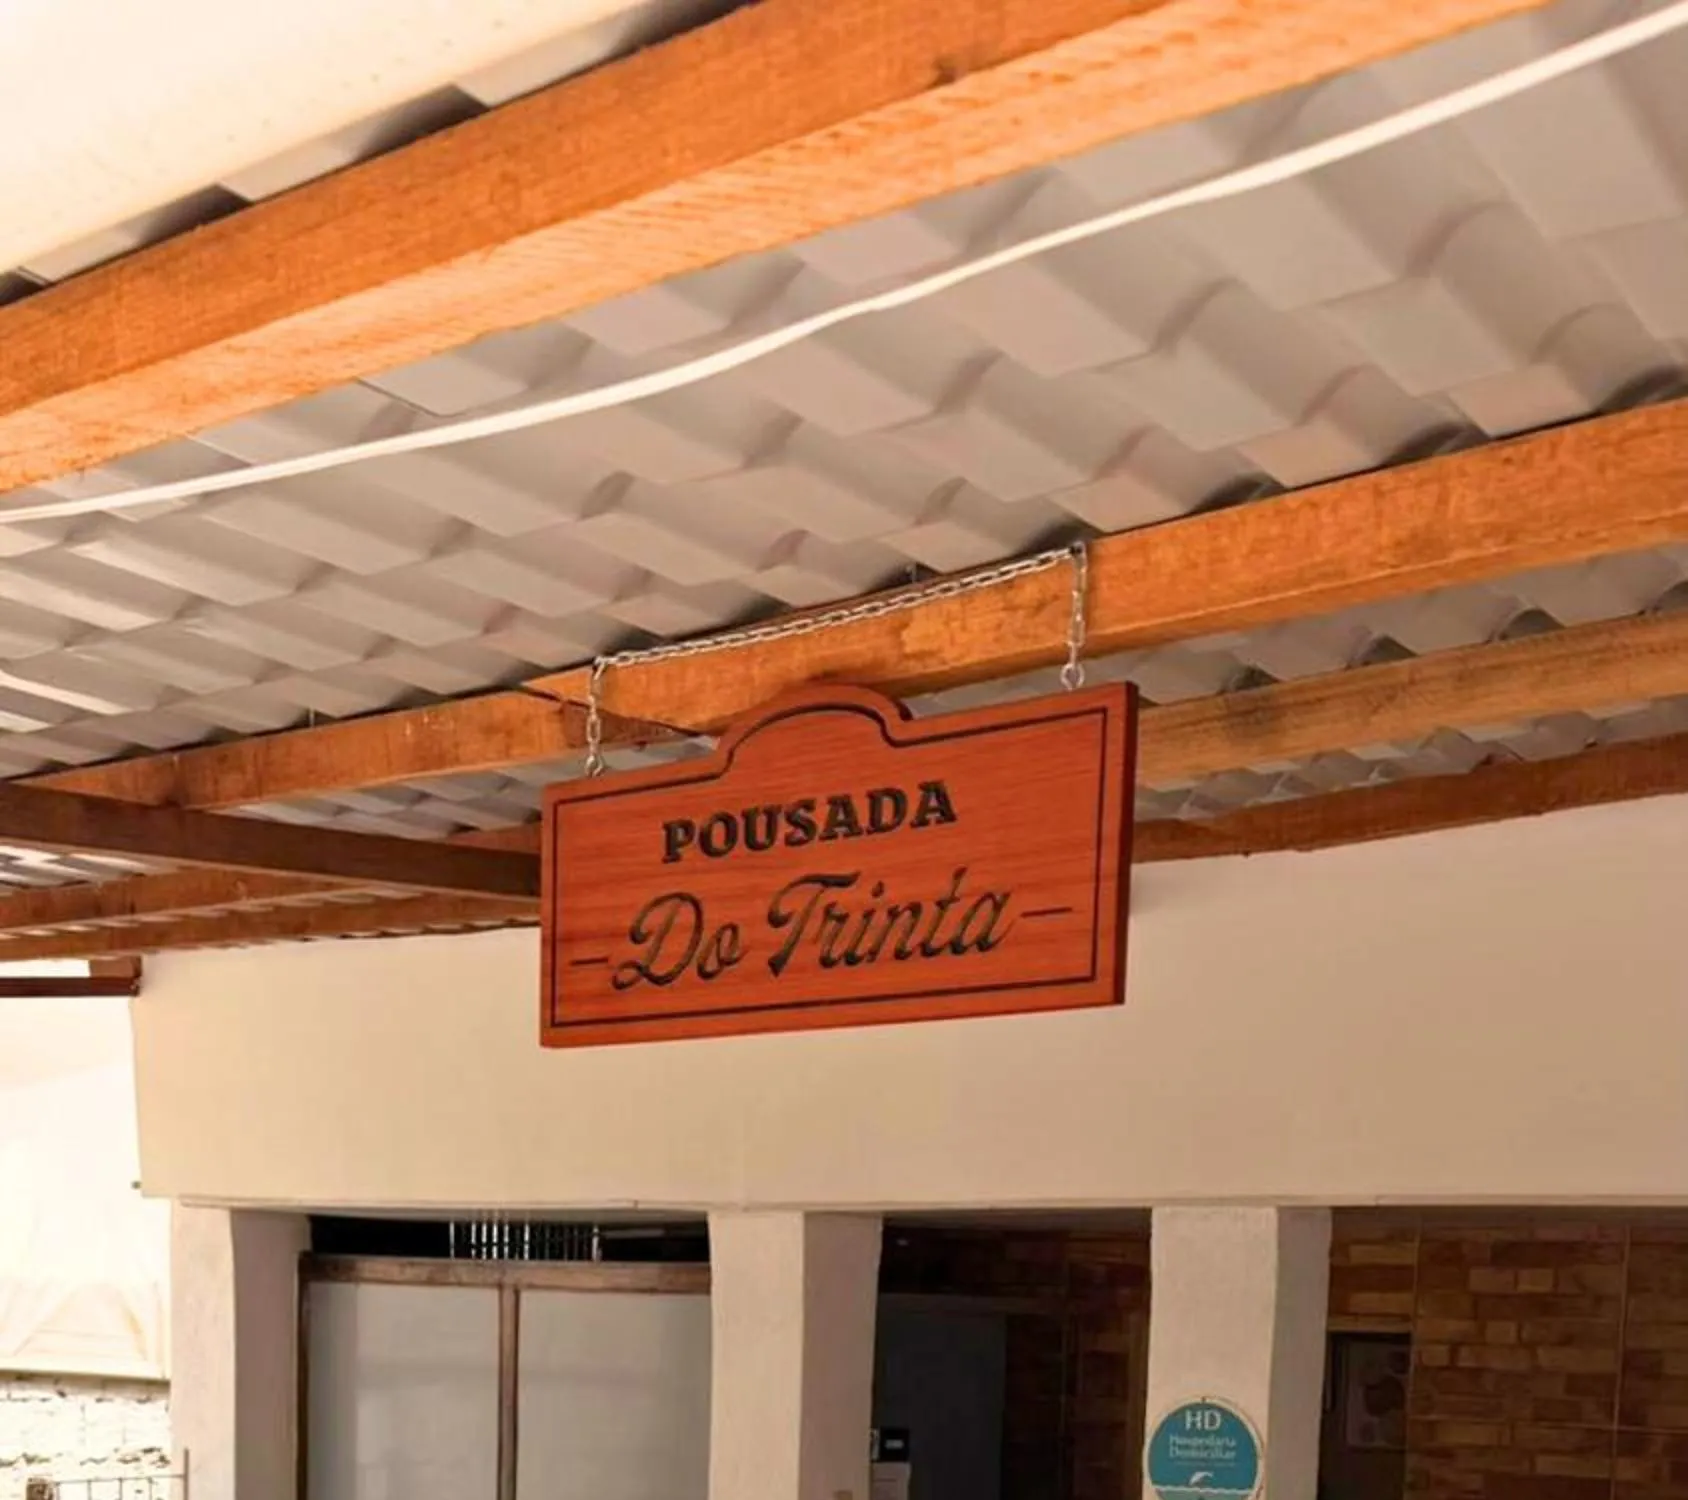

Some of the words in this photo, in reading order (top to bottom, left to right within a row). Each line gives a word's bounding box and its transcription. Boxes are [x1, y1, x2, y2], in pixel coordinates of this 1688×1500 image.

[661, 780, 958, 864] POUSADA
[610, 890, 748, 992] Do
[766, 866, 1014, 978] Trinta
[1184, 1409, 1223, 1431] HD
